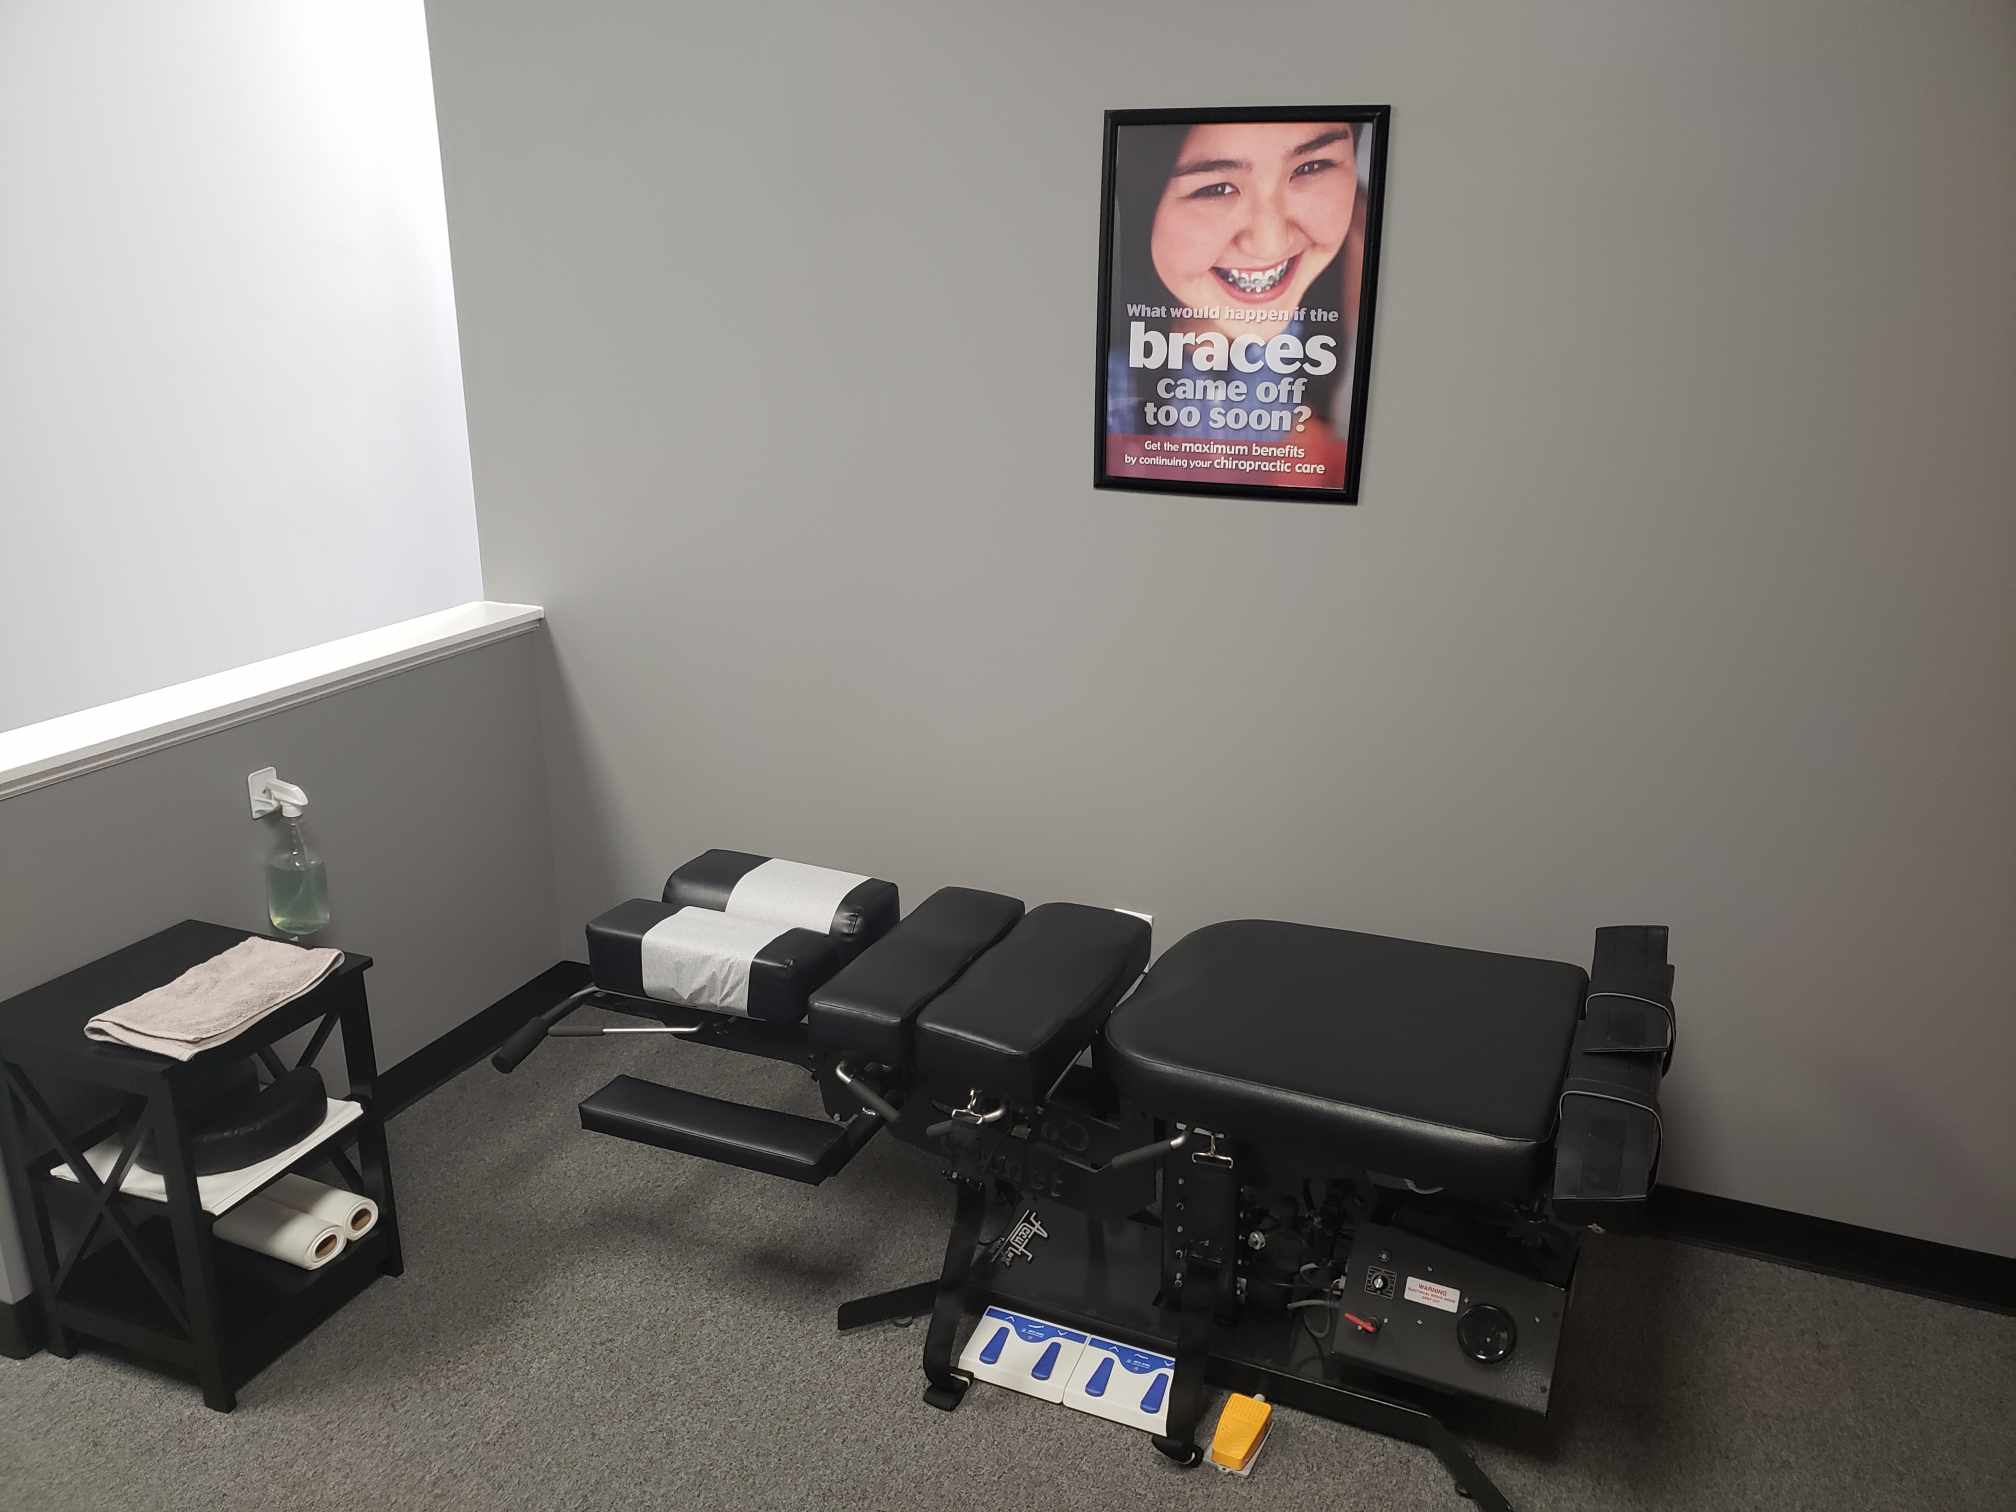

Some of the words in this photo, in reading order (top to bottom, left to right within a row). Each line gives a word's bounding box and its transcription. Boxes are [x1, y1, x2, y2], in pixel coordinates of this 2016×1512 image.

[1126, 303, 1167, 319] What
[1170, 305, 1220, 320] would
[1225, 306, 1289, 324] happen
[1294, 306, 1308, 321] if
[1310, 308, 1339, 322] the
[1129, 321, 1338, 376] braces
[1157, 377, 1248, 402] came
[1256, 377, 1309, 404] off
[1144, 402, 1201, 427] too
[1208, 404, 1312, 432] soon?
[1144, 440, 1162, 452] Get
[1163, 442, 1180, 452] the
[1181, 442, 1249, 456] maximum
[1252, 443, 1305, 458] benefits
[1124, 454, 1138, 466] by
[1139, 455, 1188, 470] continuing
[1189, 458, 1213, 471] your
[1213, 456, 1292, 474] chiropractic
[1295, 462, 1326, 475] care
